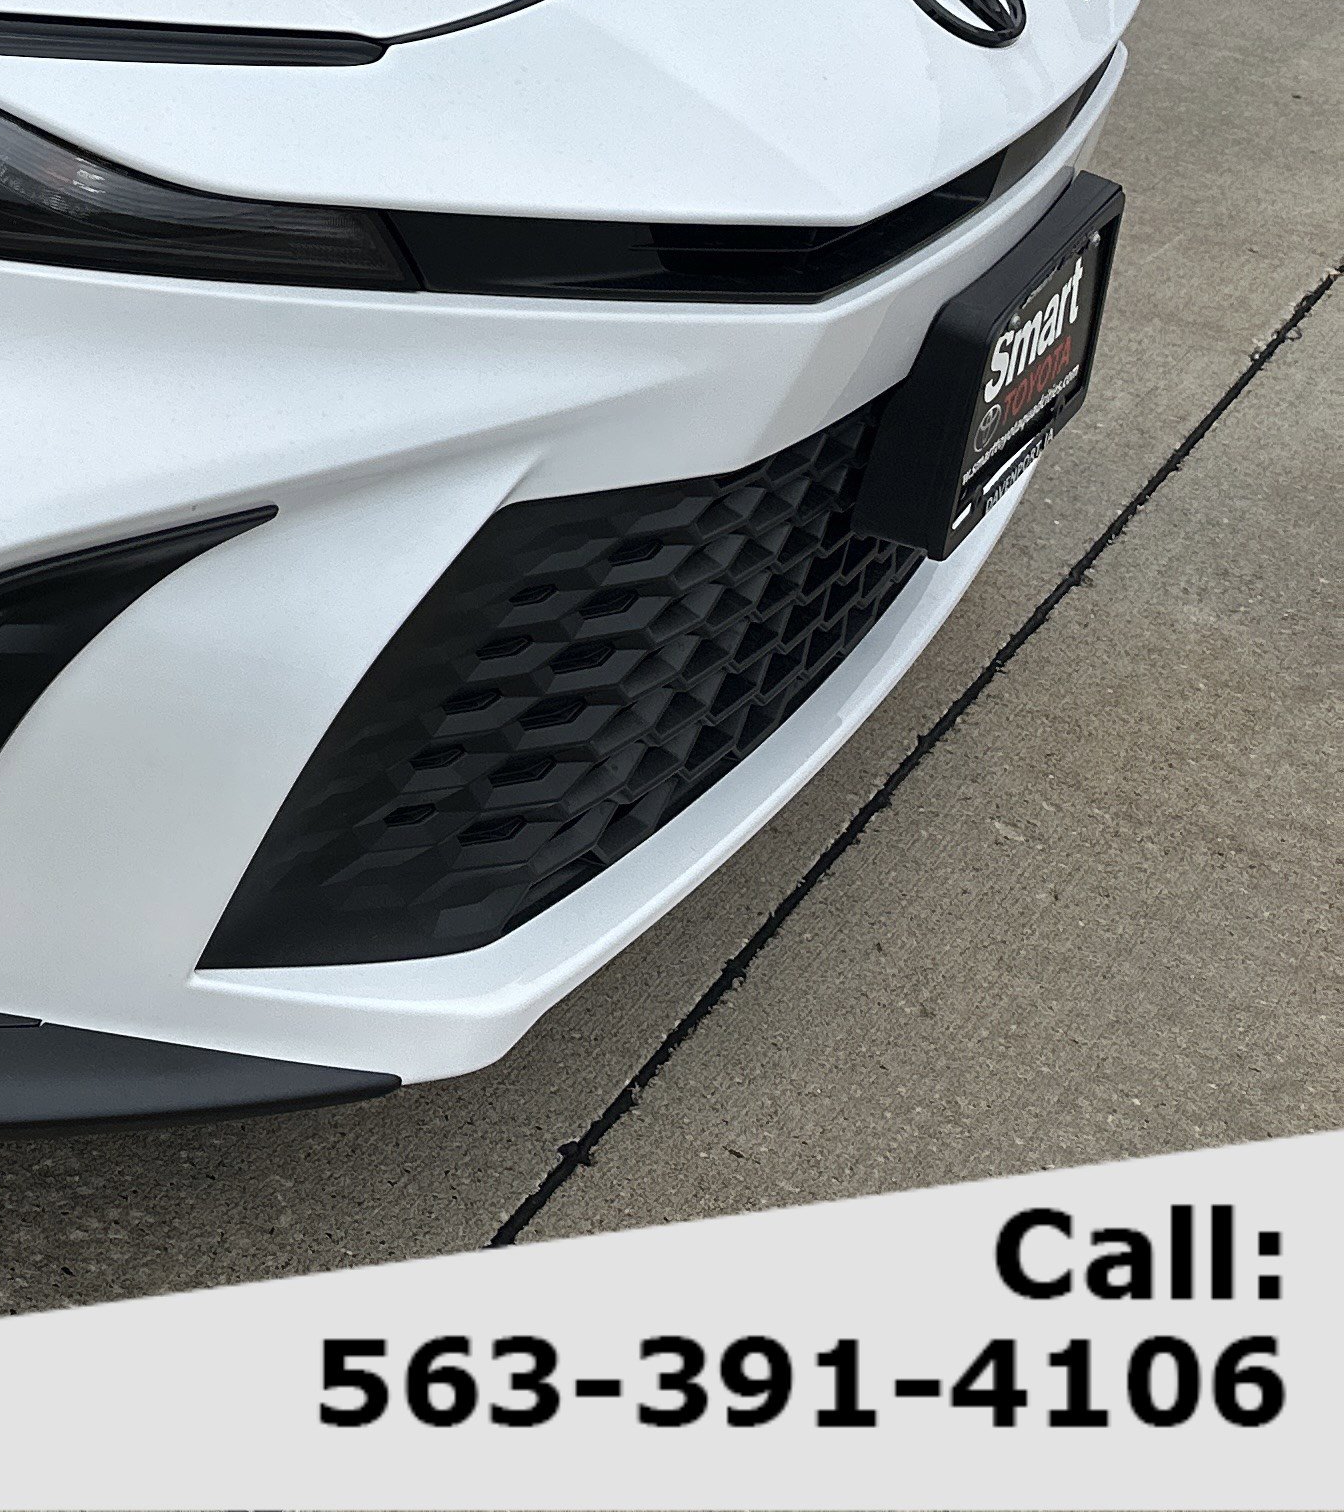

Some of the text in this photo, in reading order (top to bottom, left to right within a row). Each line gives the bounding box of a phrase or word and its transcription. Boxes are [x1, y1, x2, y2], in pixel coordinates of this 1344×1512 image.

[984, 256, 1084, 403] Smart
[1002, 335, 1072, 425] TOYOTA
[985, 439, 1043, 514] DAVENPORT
